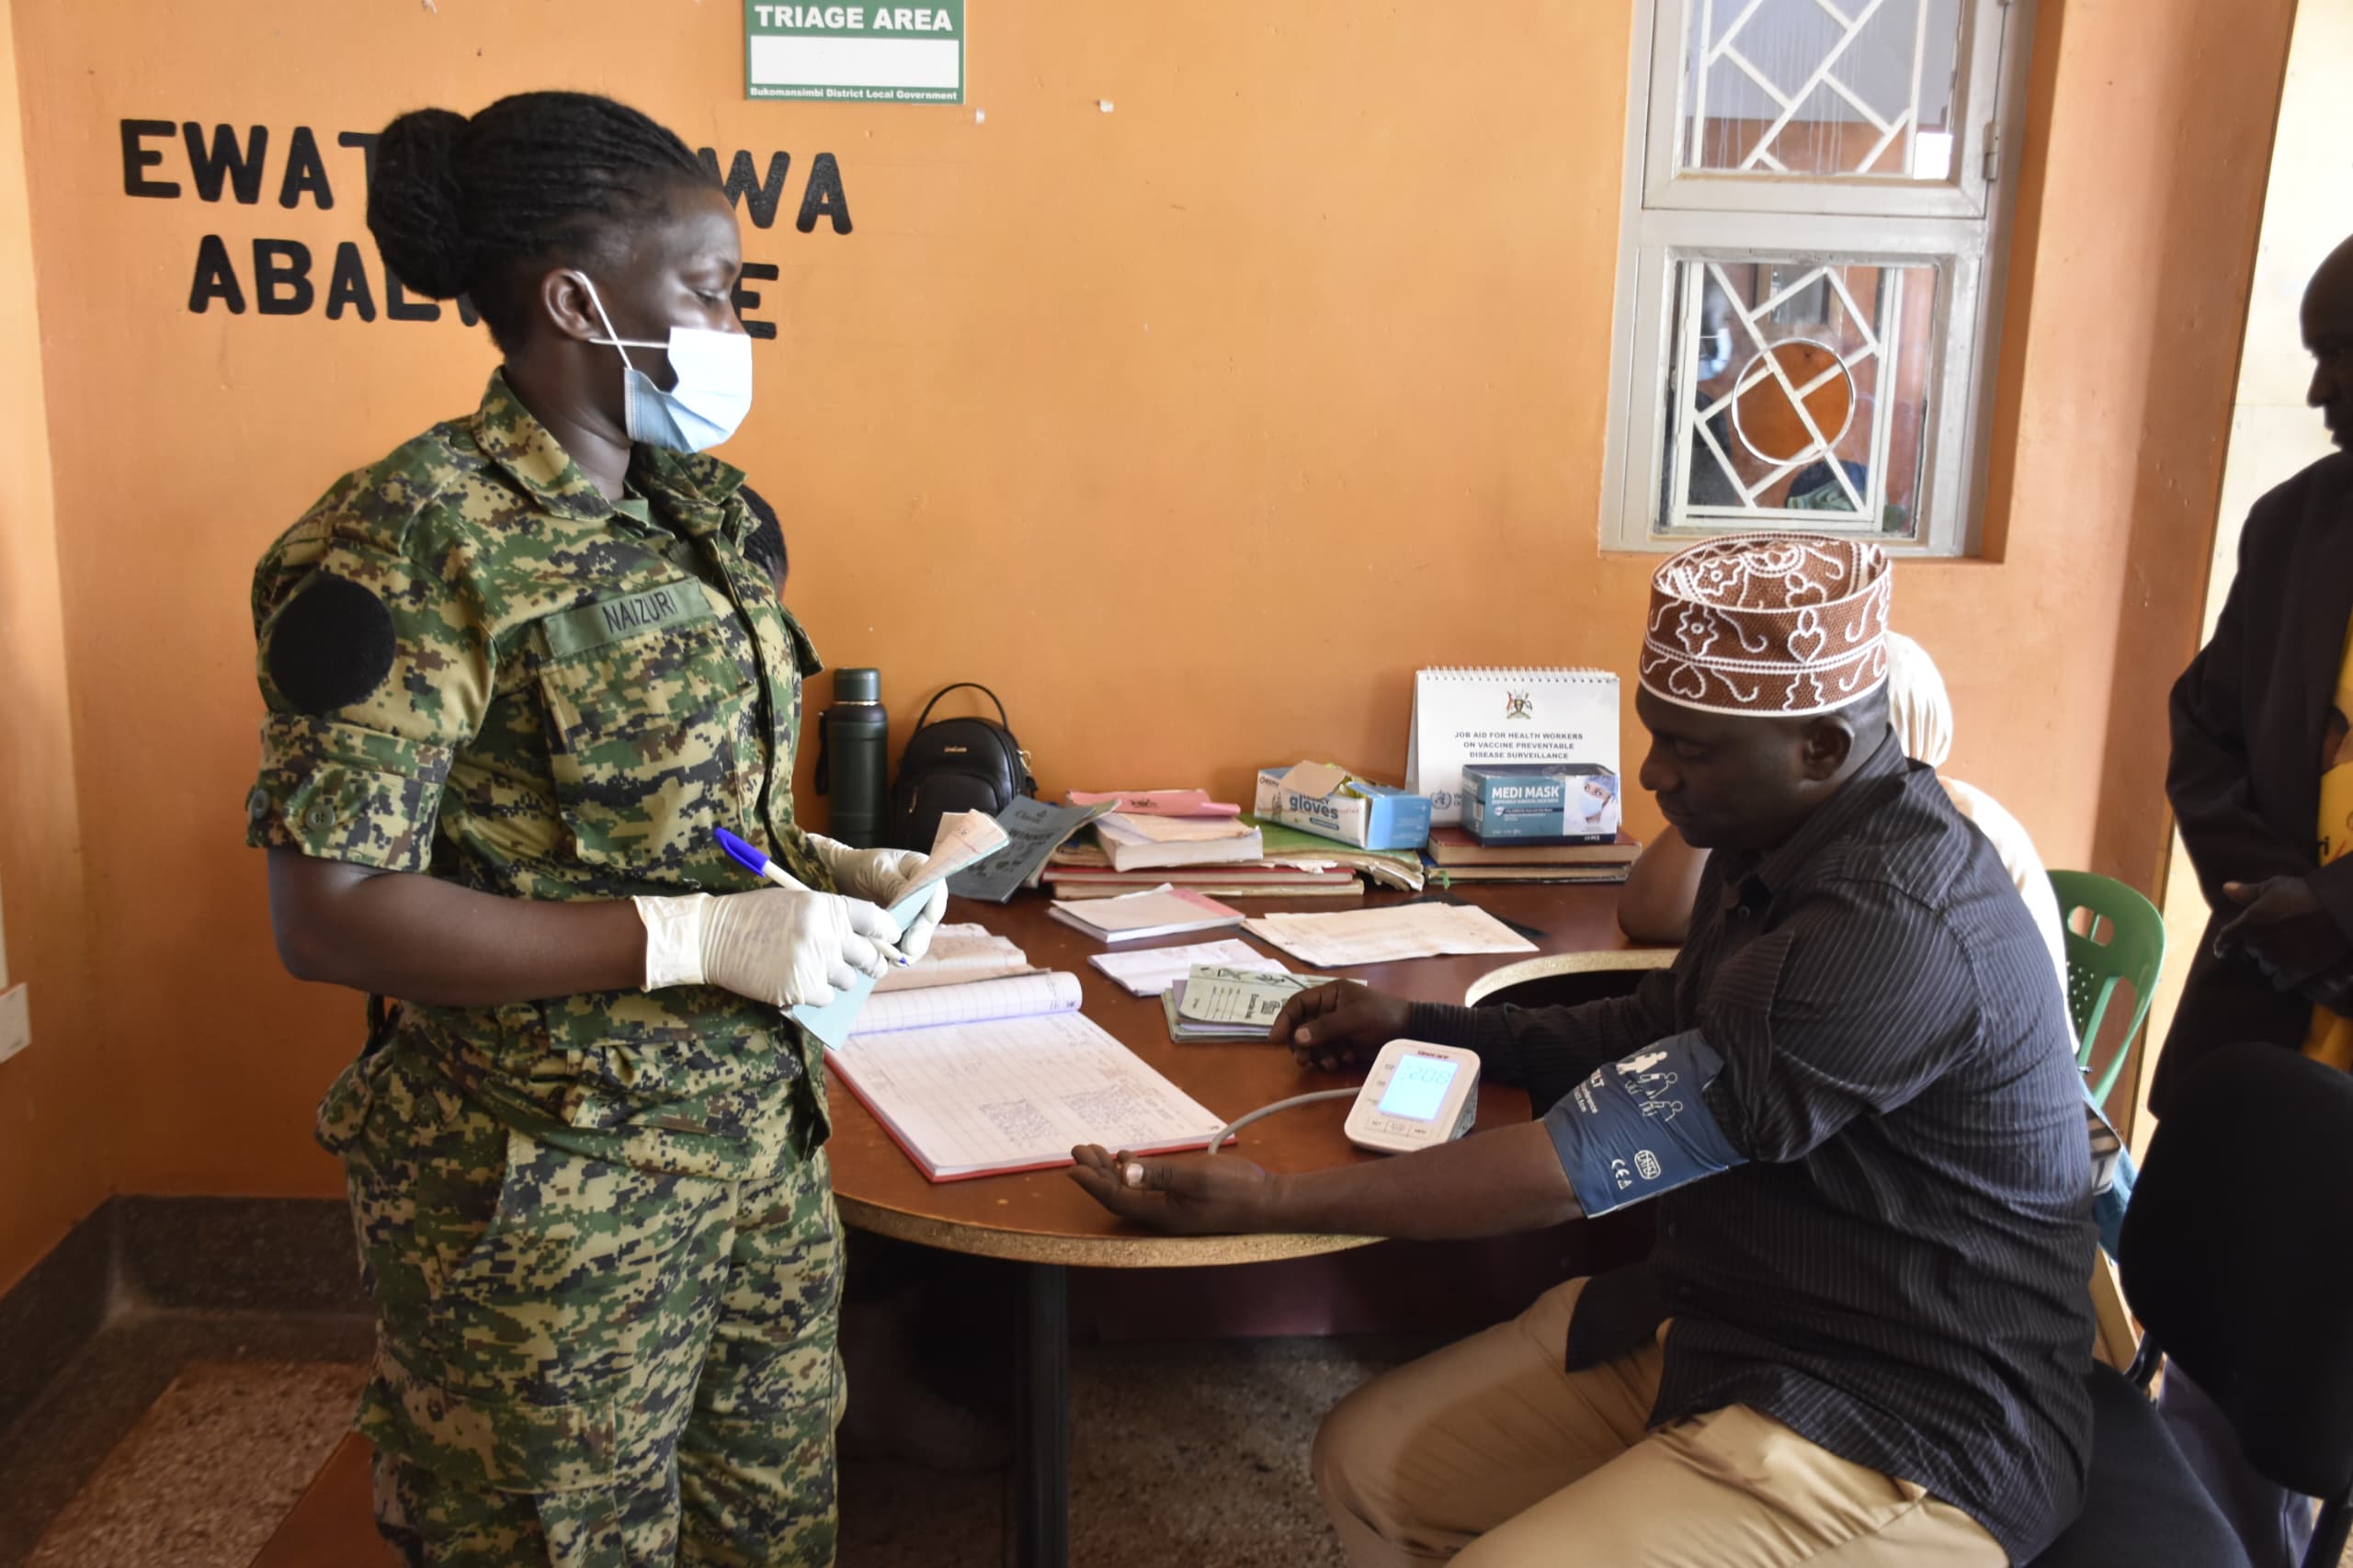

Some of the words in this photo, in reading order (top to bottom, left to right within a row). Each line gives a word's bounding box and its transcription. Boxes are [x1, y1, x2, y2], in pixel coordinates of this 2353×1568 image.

[754, 5, 864, 28] TRIAGE
[872, 7, 953, 31] AREA
[750, 86, 824, 97] Bukomansimbi
[826, 88, 863, 98] District
[866, 89, 893, 99] Local
[896, 90, 957, 100] Government
[602, 590, 677, 634] NAIZURI
[1517, 742, 1574, 750] PREVENTABLE
[1492, 786, 1522, 799] MEDI
[1526, 786, 1560, 799] MASK
[1290, 794, 1338, 819] gloves
